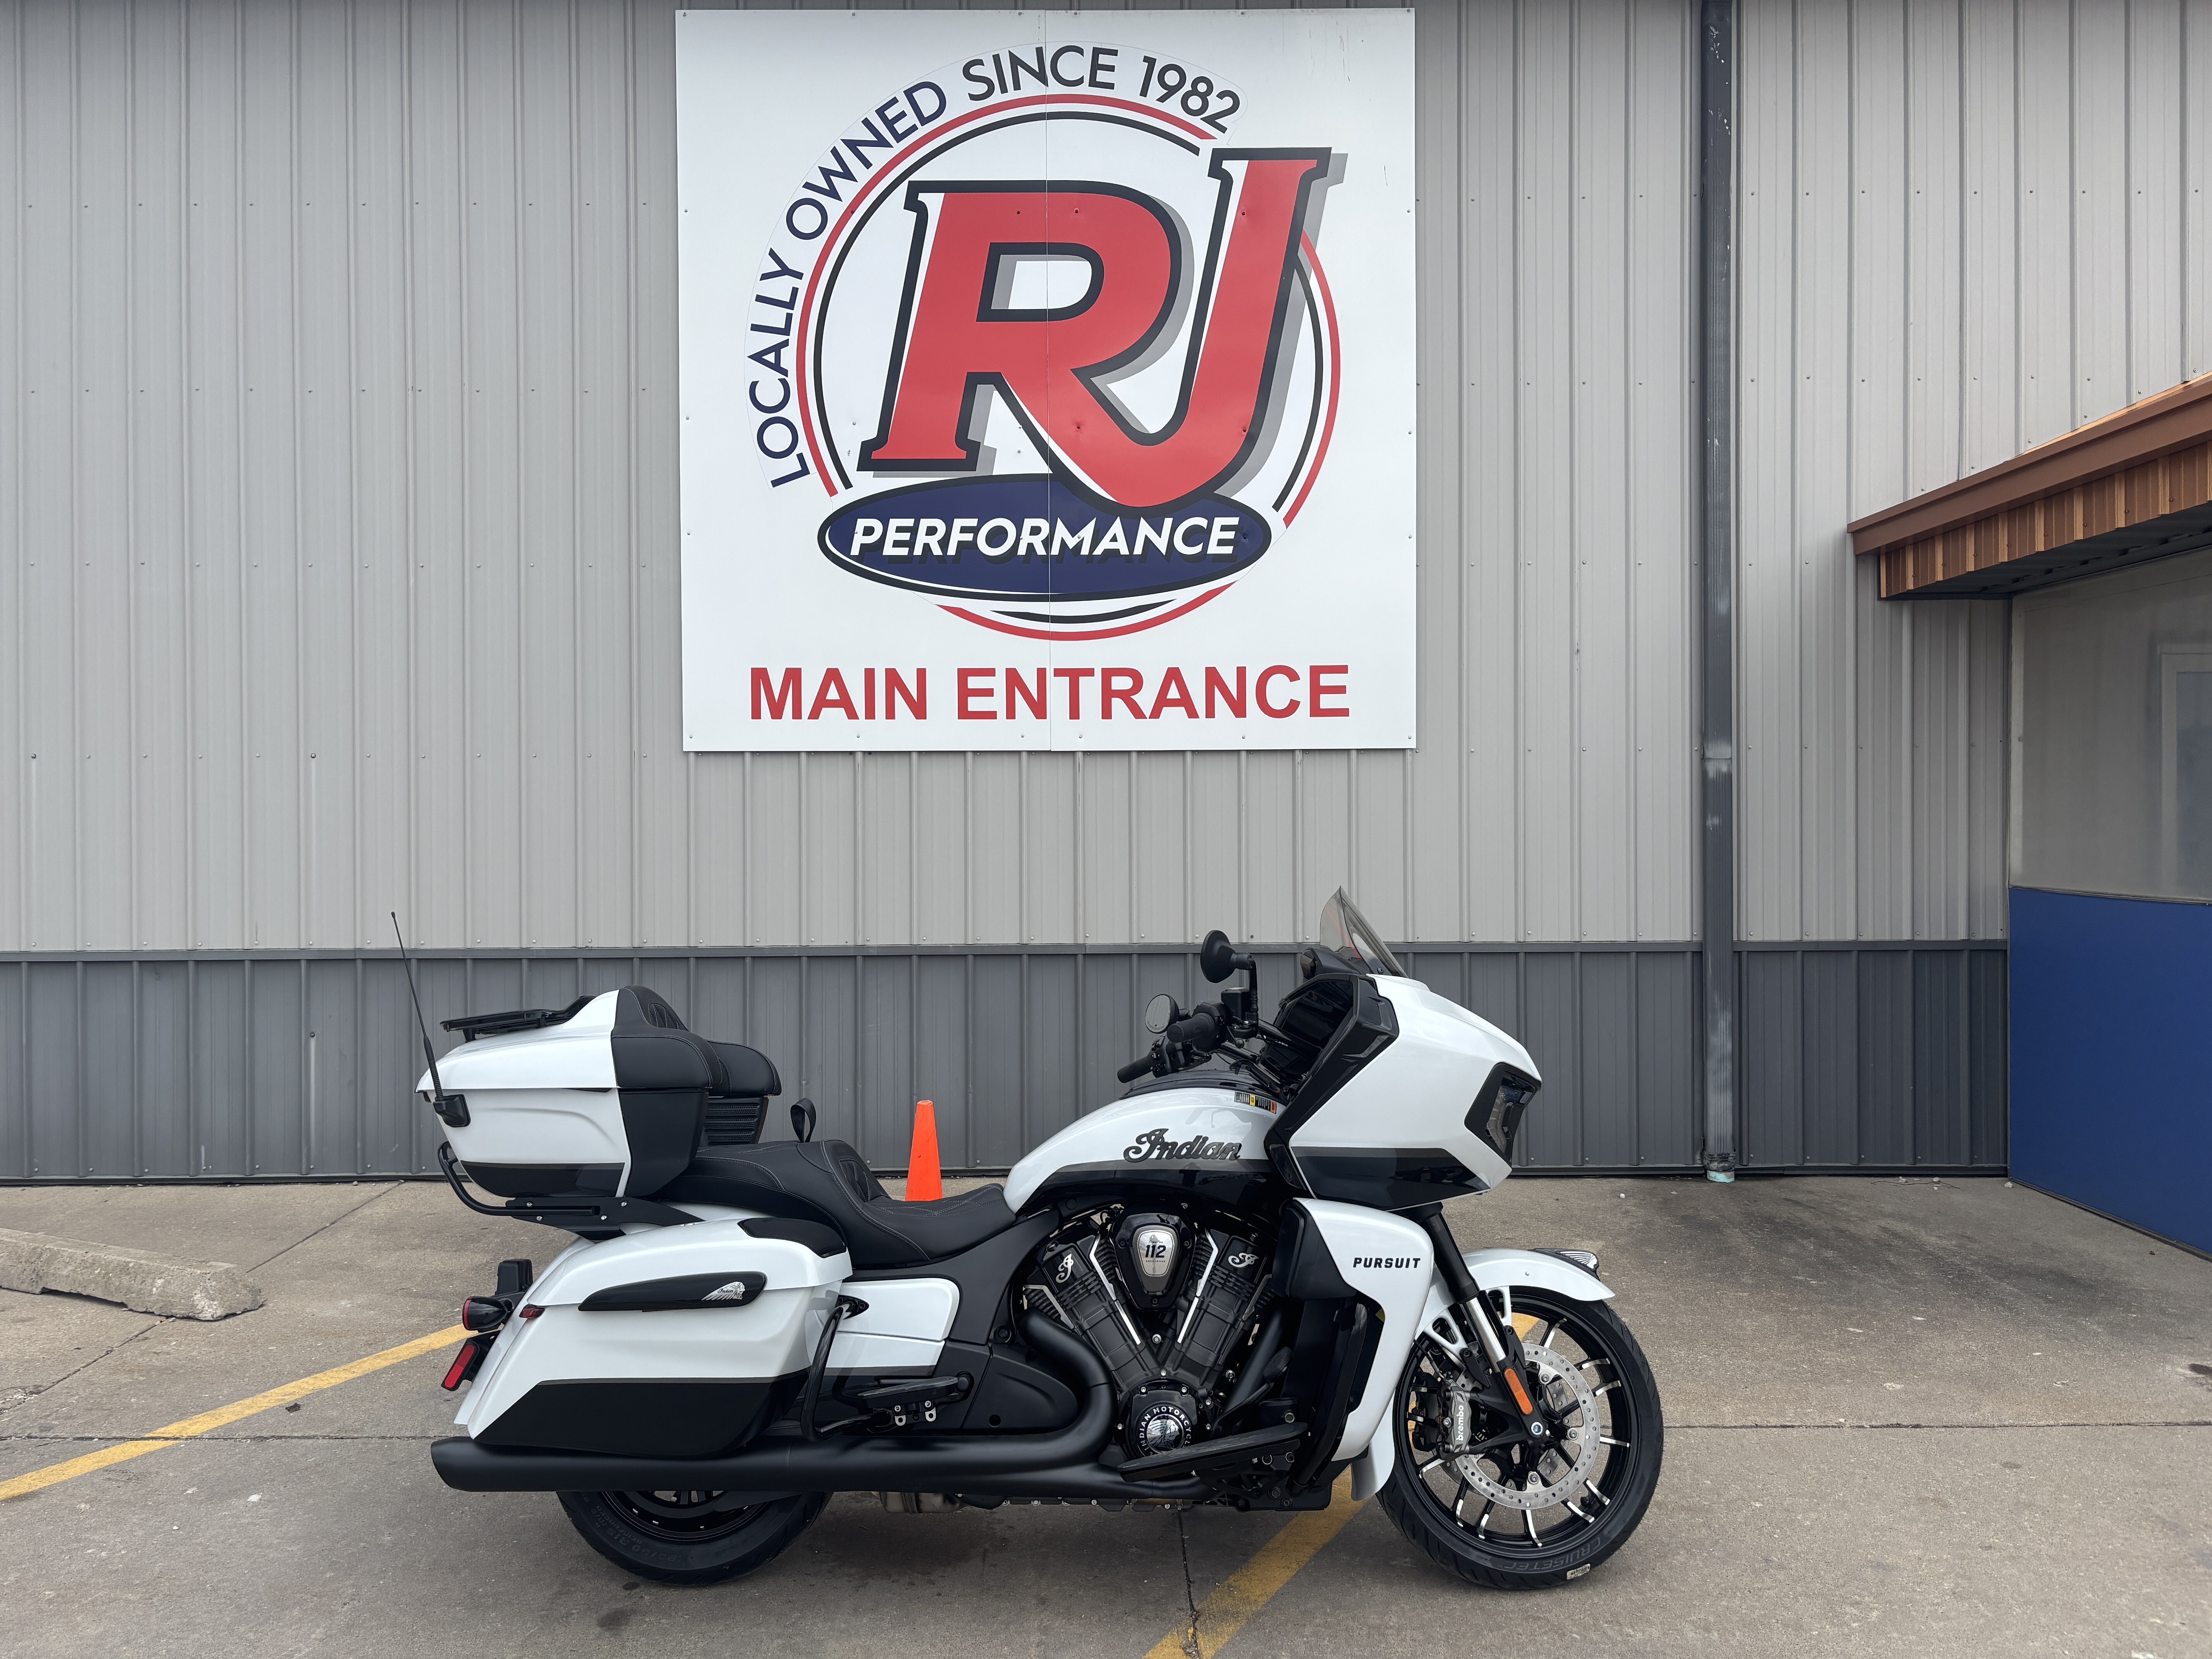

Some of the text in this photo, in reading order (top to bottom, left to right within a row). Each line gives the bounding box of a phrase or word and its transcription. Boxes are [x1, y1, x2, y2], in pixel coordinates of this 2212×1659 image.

[747, 45, 1240, 488] LOCALLY OWNED SINCE 1982
[857, 147, 1332, 515] RJ
[850, 517, 1240, 556] PERFORMANCE
[752, 666, 1349, 720] MAIN ENTRANCE
[1123, 1128, 1242, 1163] Indian
[1146, 1245, 1166, 1258] 112
[1353, 1257, 1420, 1268] PURSUIT
[1139, 1406, 1191, 1451] INDIAN MOTORCYCL
[1456, 1405, 1464, 1441] brembo
[1504, 1537, 1601, 1570] CRUISETEC
